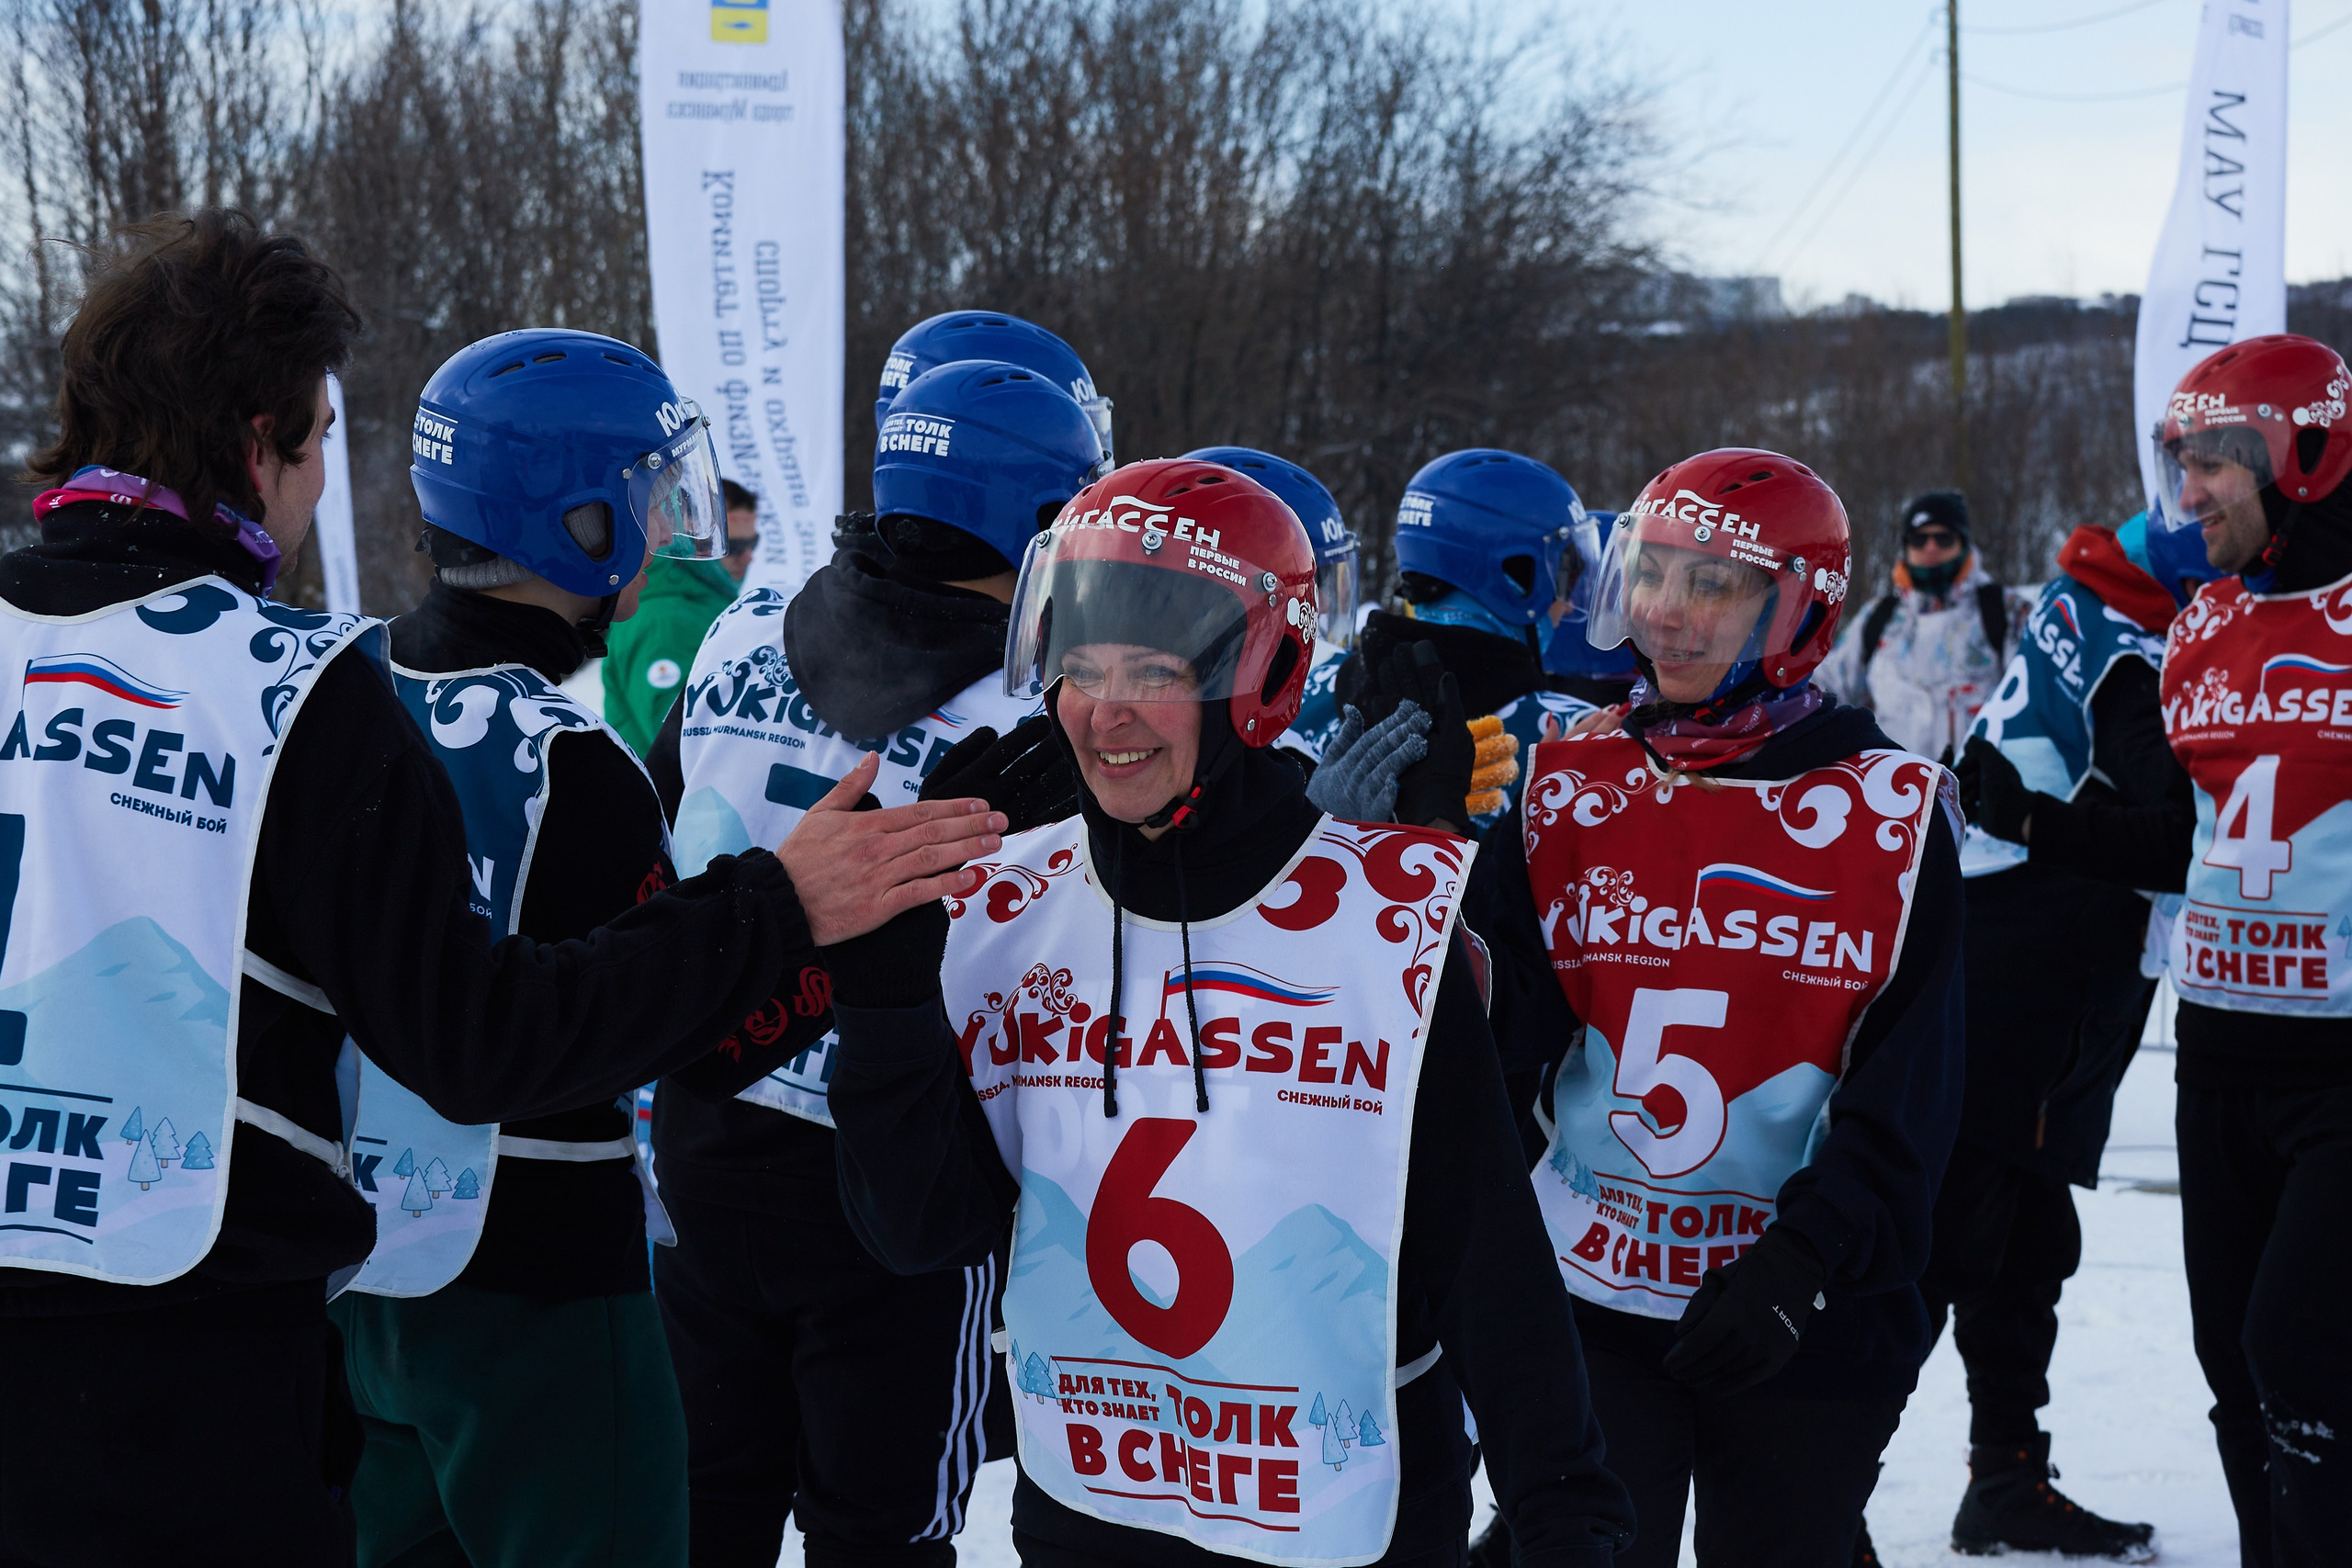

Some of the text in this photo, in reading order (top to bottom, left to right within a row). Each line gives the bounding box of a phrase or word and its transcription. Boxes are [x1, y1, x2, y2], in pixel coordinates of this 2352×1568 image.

[906, 419, 953, 439] ТОЛК
[888, 434, 950, 457] СНЕГЕ
[1190, 545, 1240, 570] ПЕРВЫЕ
[1730, 549, 1781, 570] В РОССИИ
[1732, 538, 1774, 558] ПЕРВЫЕ
[1188, 558, 1247, 587] В РОССИИ
[768, 733, 806, 750] REGION
[109, 792, 227, 834] СНЕЖНЫЙ БОЙ
[2202, 754, 2291, 900] 4
[2227, 919, 2326, 951] ТОЛК
[1625, 953, 1670, 967] REGION
[2197, 947, 2328, 989] СНЕГЕ
[1782, 970, 1841, 988] СНЕЖНЫЙ
[1609, 987, 1729, 1179] 5
[1277, 1089, 1384, 1115] СНЕЖНЫЙ БОЙ
[1599, 1184, 1624, 1206] ДЛЯ
[1596, 1202, 1617, 1221] КТО
[1645, 1200, 1770, 1239] ТОЛК
[1086, 1118, 1234, 1359] 6
[1571, 1222, 1611, 1263] В
[1058, 1373, 1156, 1402] ДЛЯ ТЕХ,
[1062, 1398, 1159, 1422] КТО ЗНАЕТ
[1166, 1383, 1298, 1448] ТОЛК
[1066, 1423, 1300, 1514] В СНЕГЕ
